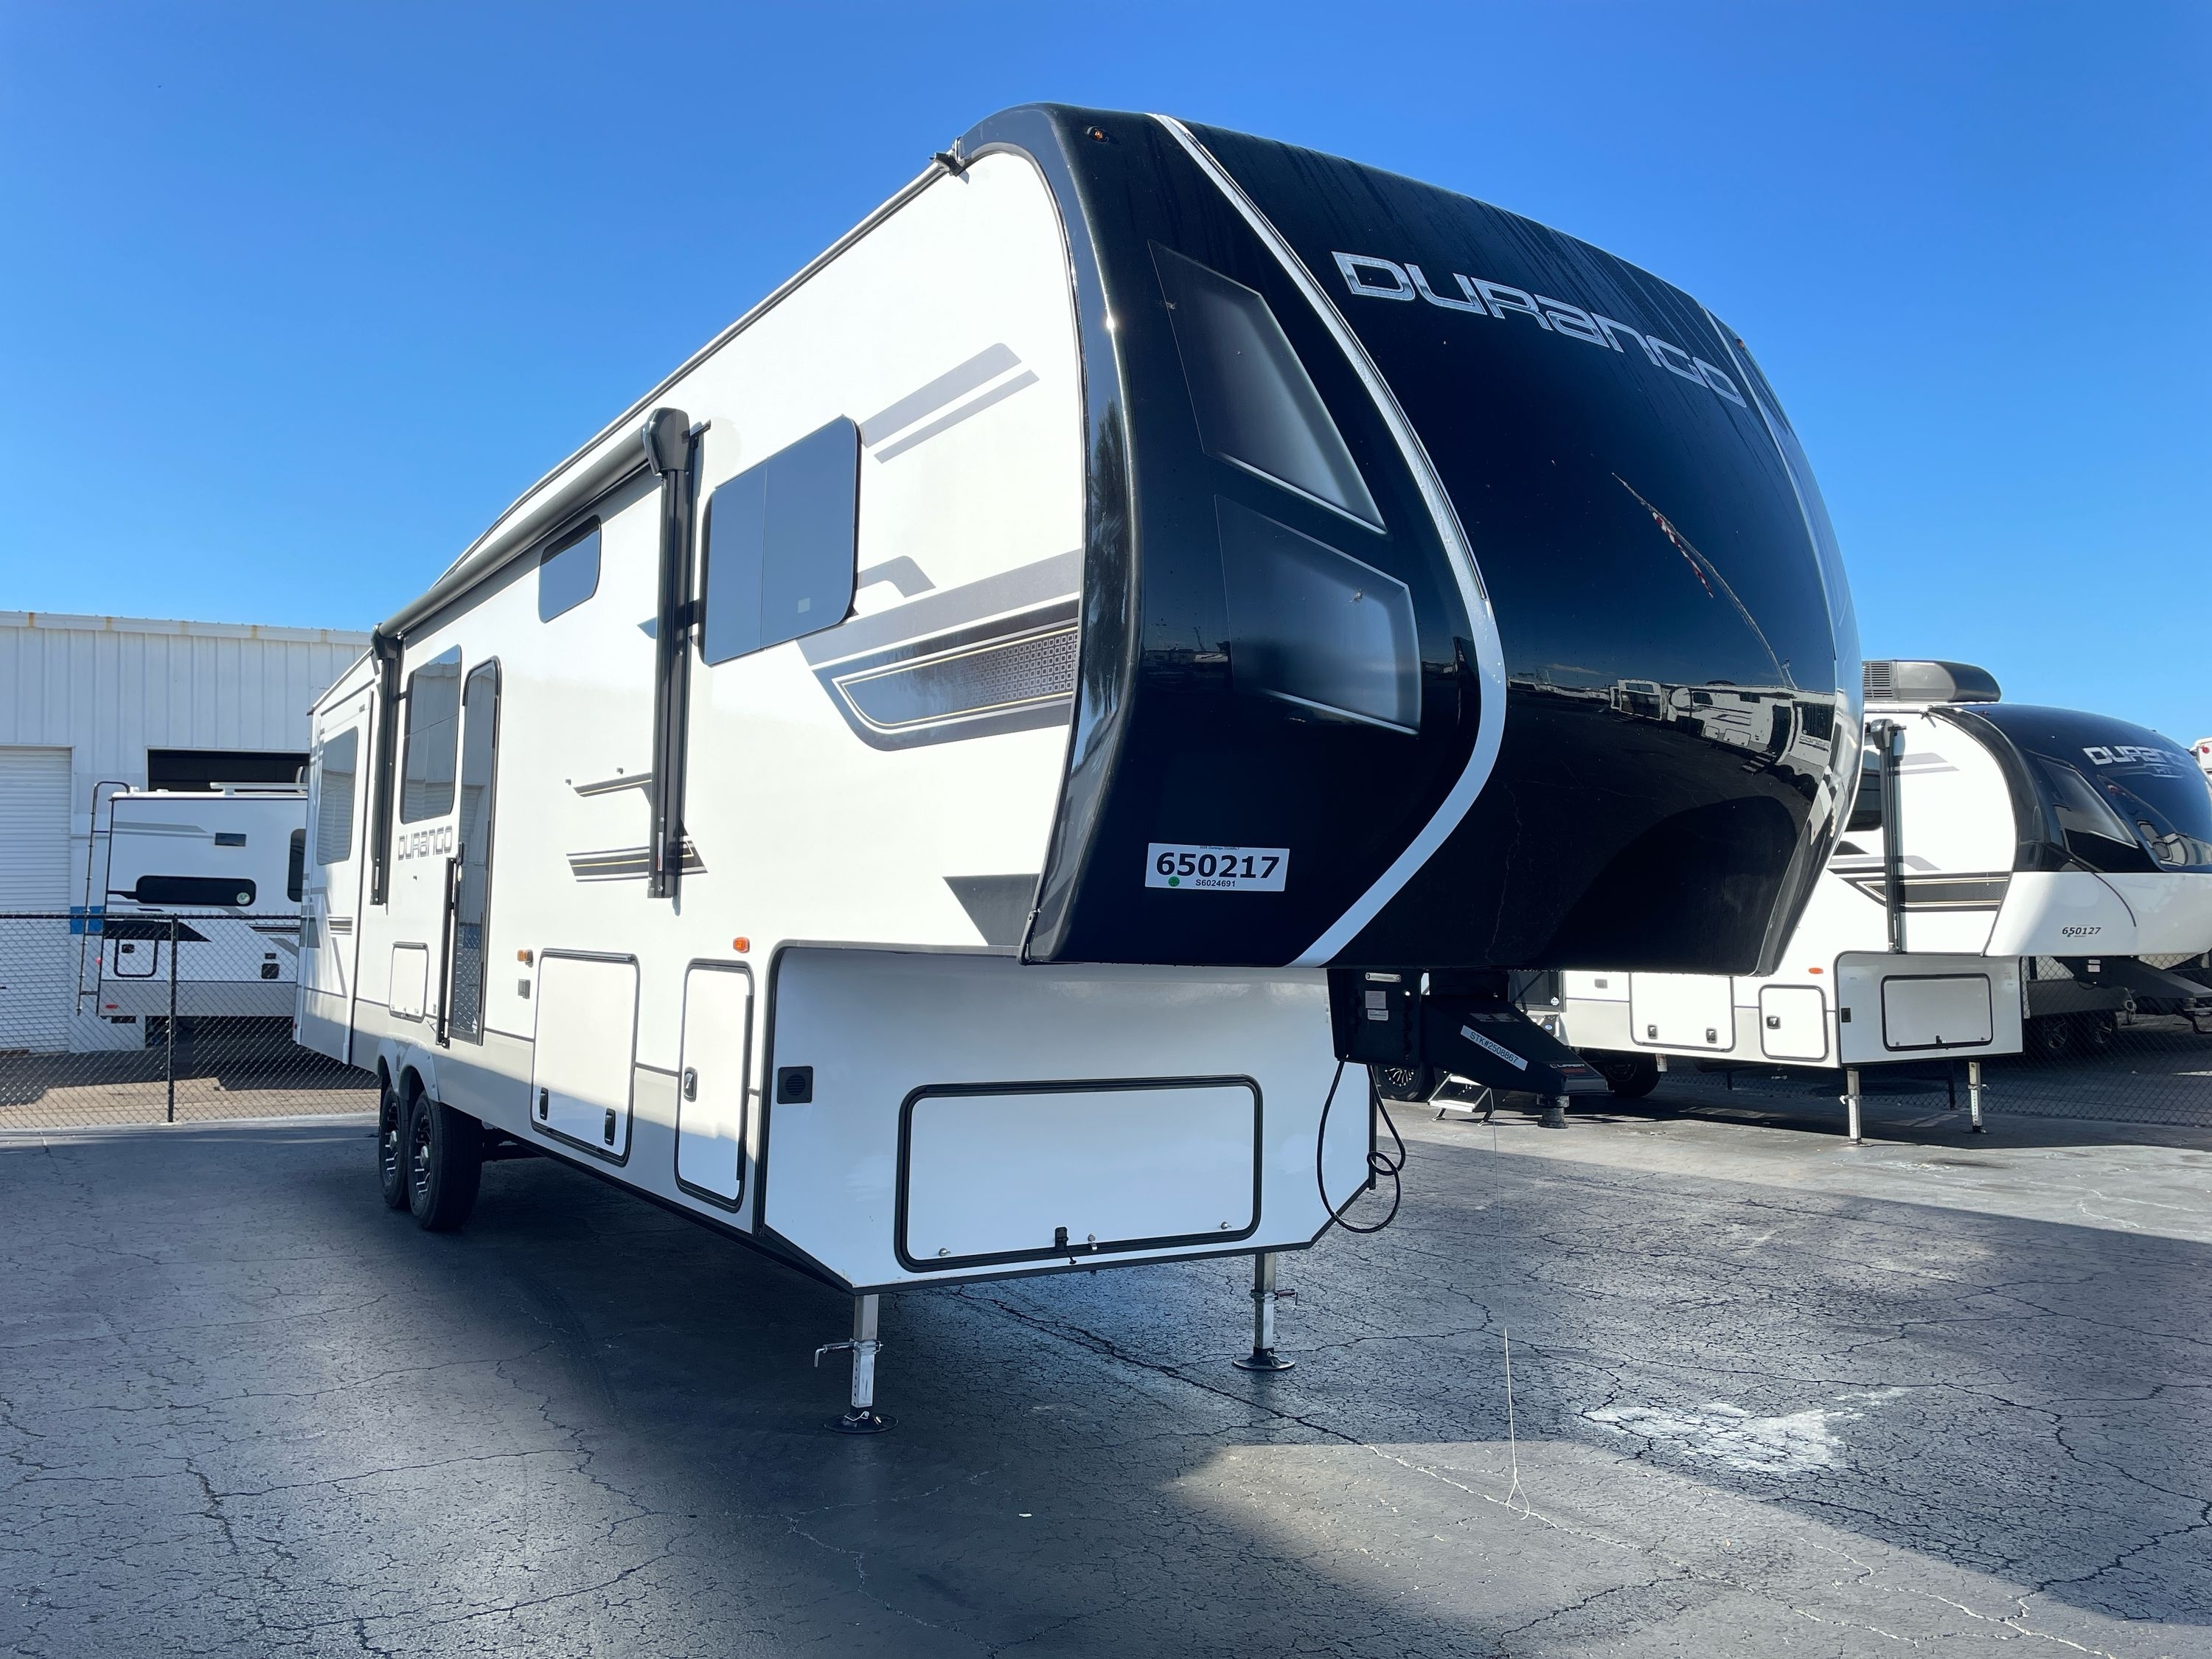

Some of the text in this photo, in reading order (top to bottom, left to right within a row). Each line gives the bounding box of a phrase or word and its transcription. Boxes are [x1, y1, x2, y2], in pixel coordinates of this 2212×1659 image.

[1156, 852, 1280, 879] 650217
[1195, 879, 1236, 887] S6024691
[1470, 1032, 1519, 1063] STK#2508867
